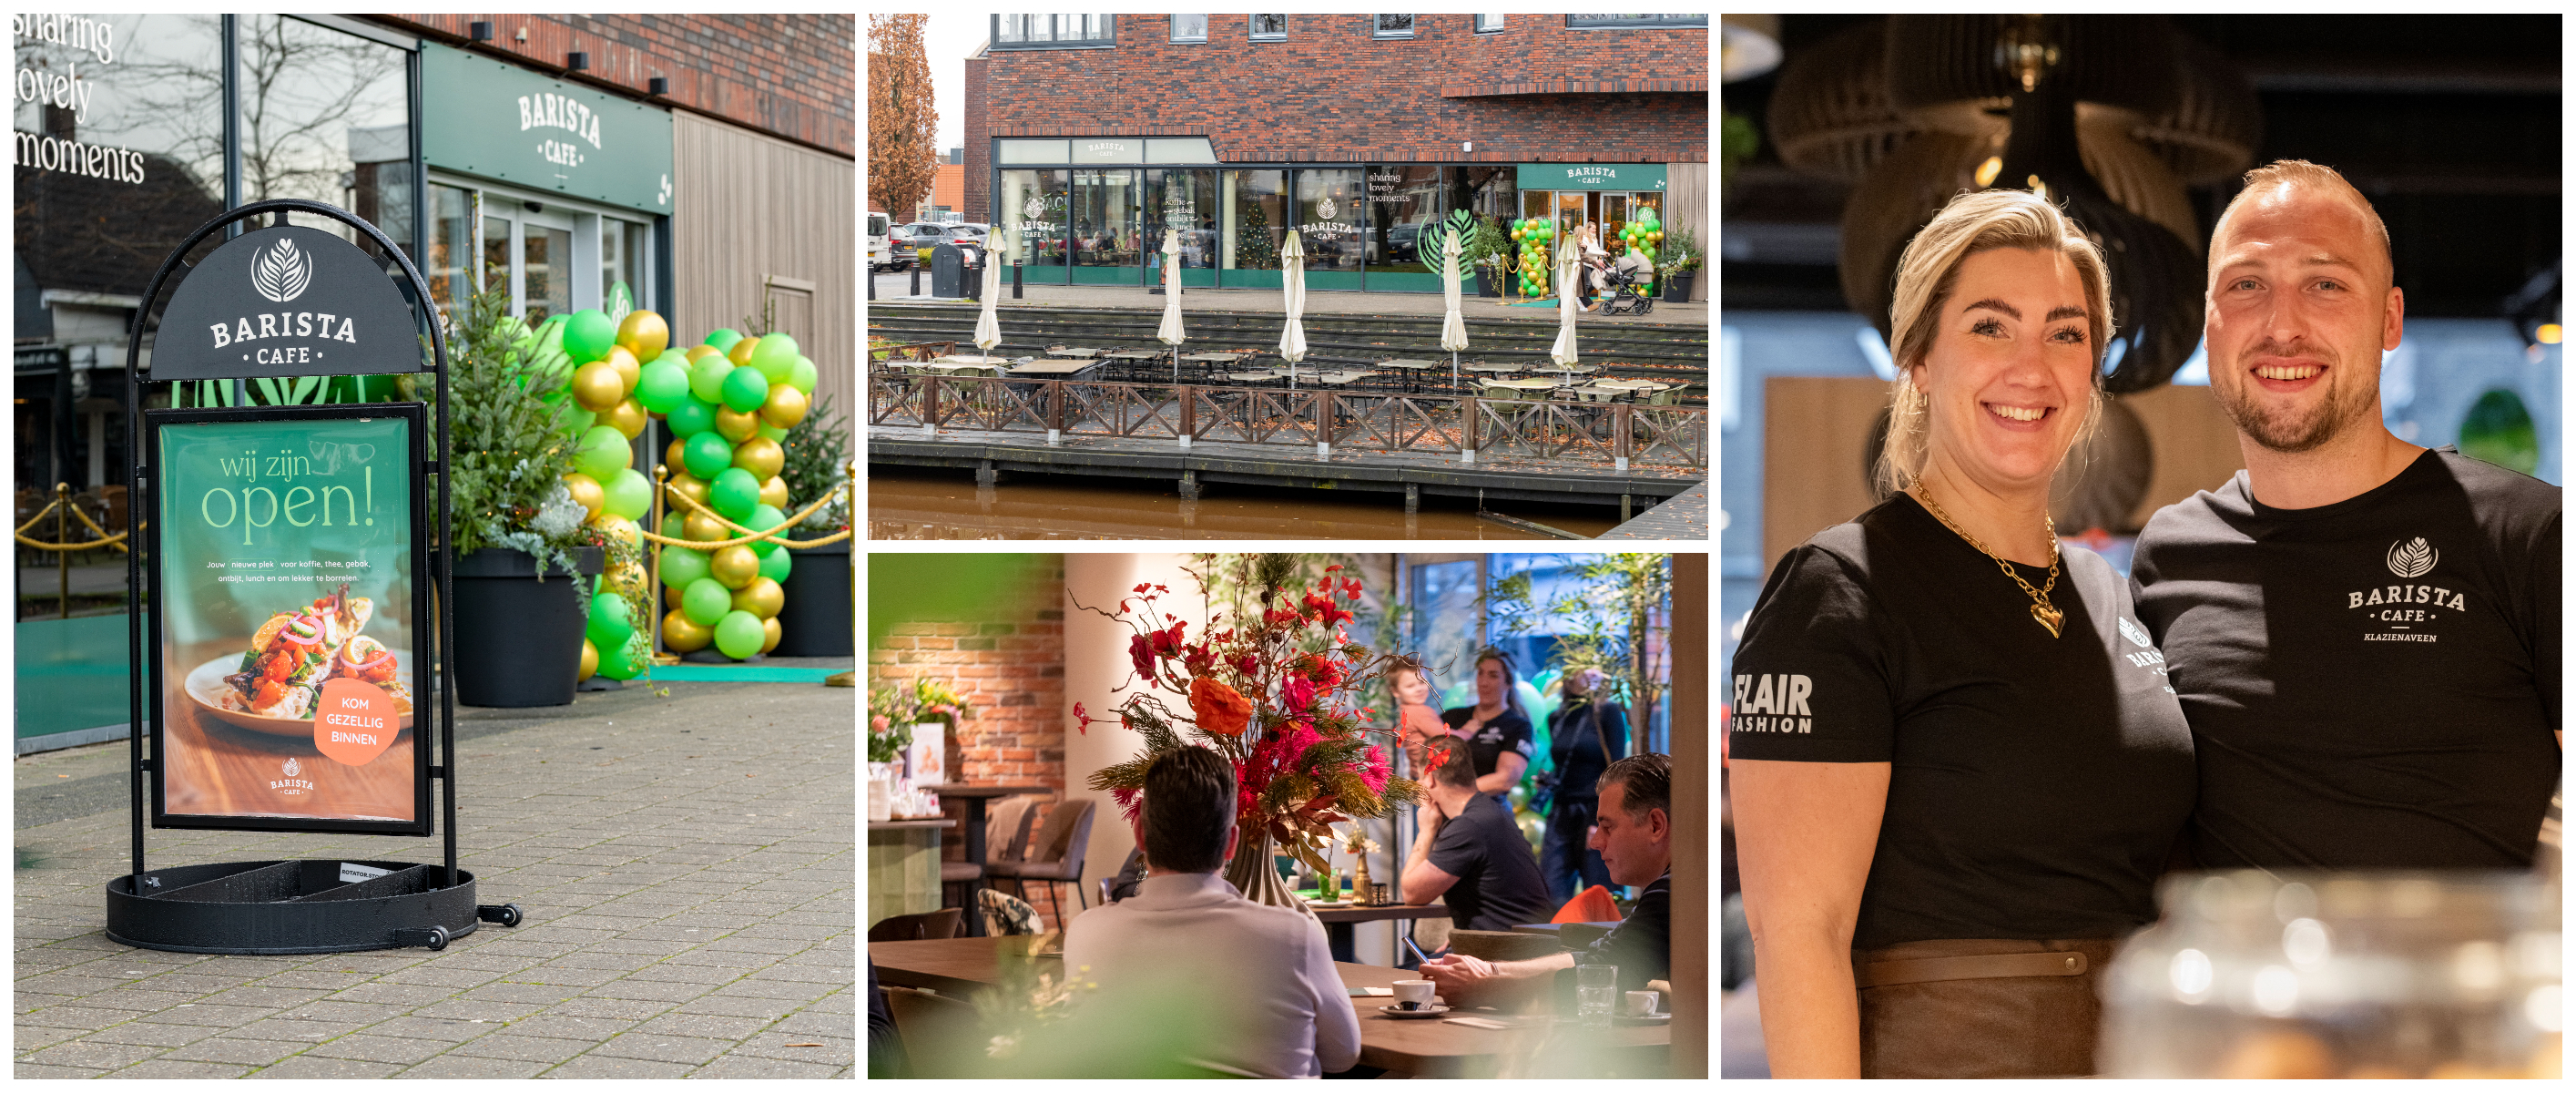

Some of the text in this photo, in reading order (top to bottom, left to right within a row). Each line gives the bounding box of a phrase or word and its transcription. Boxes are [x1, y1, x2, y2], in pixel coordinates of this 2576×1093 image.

[518, 93, 601, 150] BARISTA
[1088, 142, 1125, 152] BARISTA
[14, 131, 145, 184] moments
[545, 139, 577, 168] CAFE
[1369, 172, 1401, 182] sharing
[1566, 167, 1616, 178] BARISTA
[1369, 182, 1394, 193] lovely
[1165, 198, 1186, 206] koffie
[1369, 194, 1410, 202] moments
[1173, 206, 1196, 215] gebak
[1165, 214, 1188, 223] ontbijt
[1011, 220, 1055, 231] BARISTA
[1175, 222, 1195, 230] lunch
[1302, 221, 1352, 233] BARISTA
[209, 312, 356, 349] BARISTA
[257, 347, 310, 364] CAFE
[219, 449, 311, 483] wij zijn
[201, 465, 374, 546] open!
[259, 560, 274, 569] plek
[299, 560, 323, 568] koffie,
[324, 560, 344, 568] thee,
[345, 560, 371, 569] gebak,
[218, 575, 244, 584] ontbijt,
[325, 574, 360, 582] borrelen.
[2348, 585, 2465, 612] BARISTA
[2381, 609, 2426, 621] CAFE
[2364, 633, 2437, 642] KLAZIENAVEEN
[1733, 674, 1813, 716] FLAIR
[341, 697, 370, 710] KOM
[326, 713, 383, 729] GEZELLIG
[1732, 717, 1812, 734] FASHION
[331, 730, 377, 746] BINNEN
[270, 779, 314, 791] BARISTA
